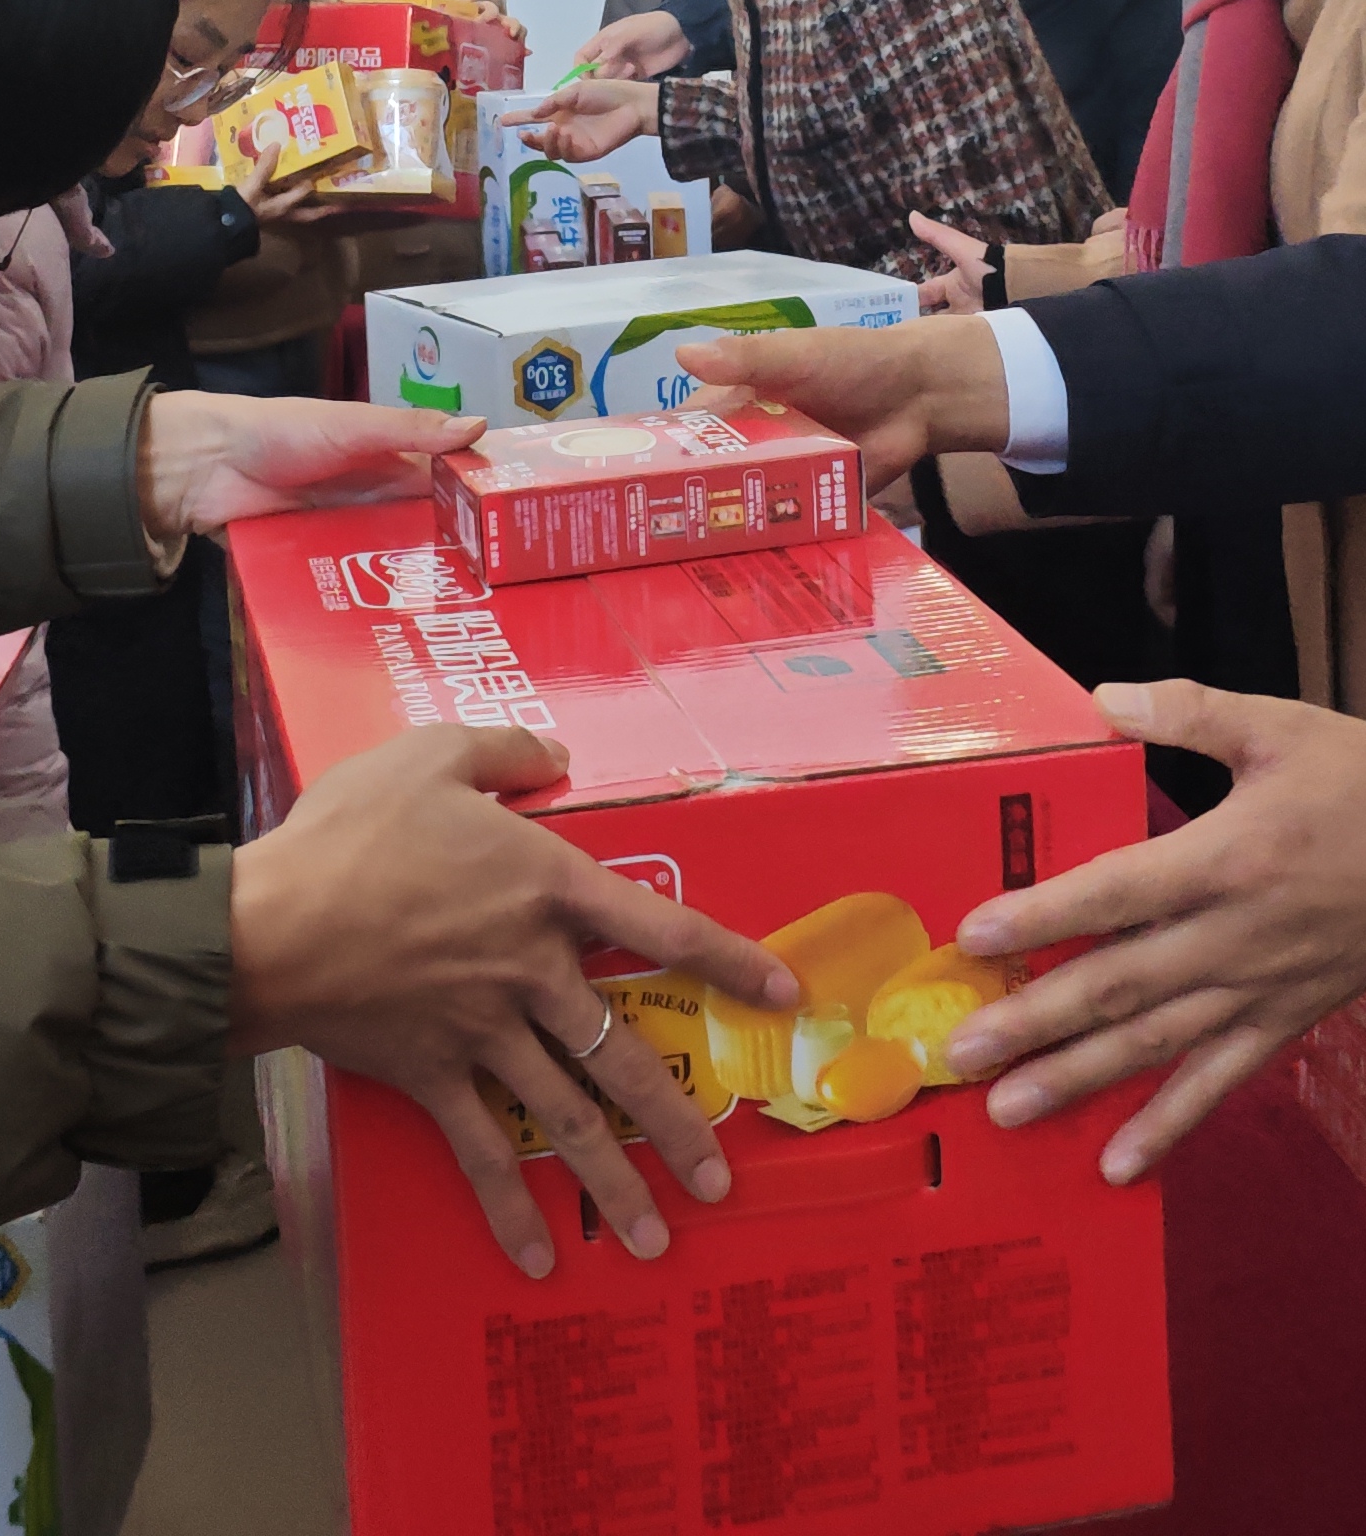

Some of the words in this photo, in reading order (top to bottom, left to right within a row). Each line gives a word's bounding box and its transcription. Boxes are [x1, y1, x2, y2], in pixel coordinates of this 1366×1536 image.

[527, 364, 567, 390] 3.0g
[371, 622, 425, 681] PANPAN
[639, 991, 699, 1017] BREAD
